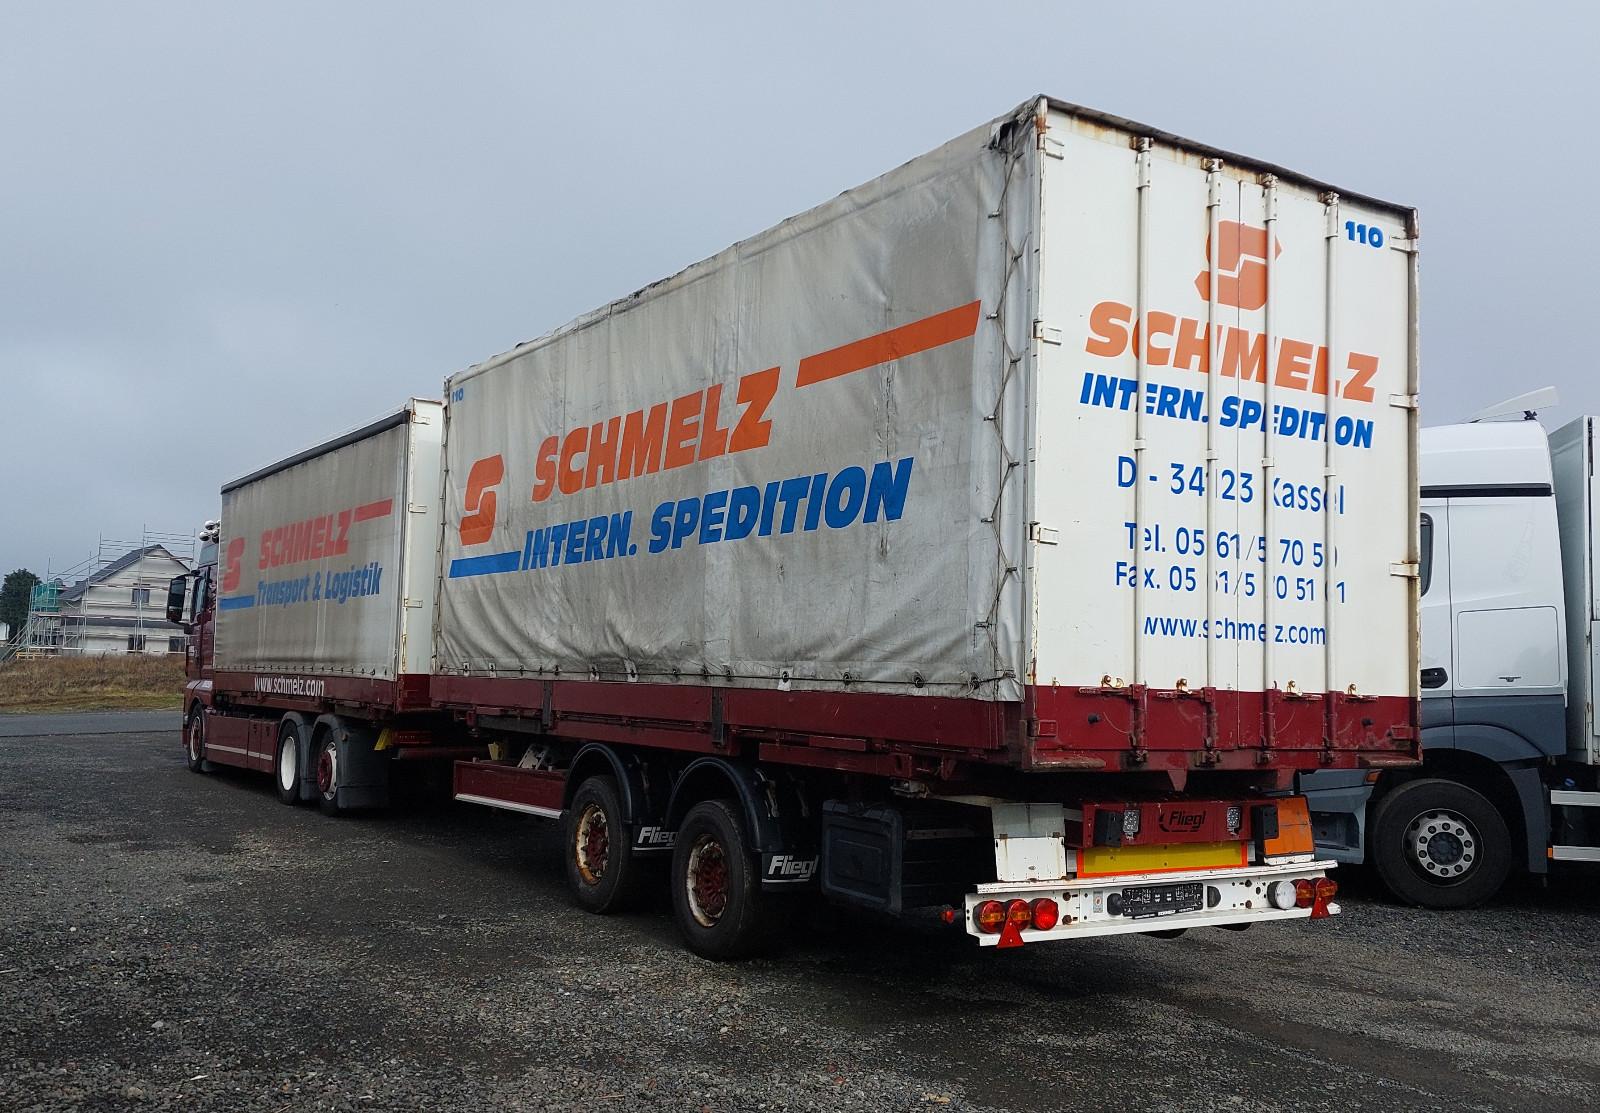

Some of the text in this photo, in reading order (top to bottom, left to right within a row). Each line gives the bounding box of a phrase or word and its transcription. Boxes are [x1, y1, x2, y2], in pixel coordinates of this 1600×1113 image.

[1345, 221, 1384, 248] 110
[1085, 301, 1380, 403] SCHMELZ
[452, 388, 464, 404] 110
[531, 366, 781, 503] SCHMELZ
[1118, 456, 1137, 488] D
[1170, 462, 1254, 503] 3423
[521, 457, 915, 571] INTERN. SPEDITION
[258, 509, 353, 571] SCHMELZ
[1124, 522, 1166, 553] Tel.
[1176, 527, 1205, 556] 05
[1280, 539, 1304, 566] 70
[1313, 543, 1337, 568] 5
[256, 561, 383, 608] Transport & Logistik
[1116, 561, 1345, 604] Fax. 05 1/5 0 51 1
[1144, 616, 1326, 646] www.schmez.com
[254, 675, 325, 697] www.schmelz.com
[637, 826, 680, 847] Flieg
[1169, 810, 1207, 829] Fliegl
[768, 855, 819, 878] Fliegl
